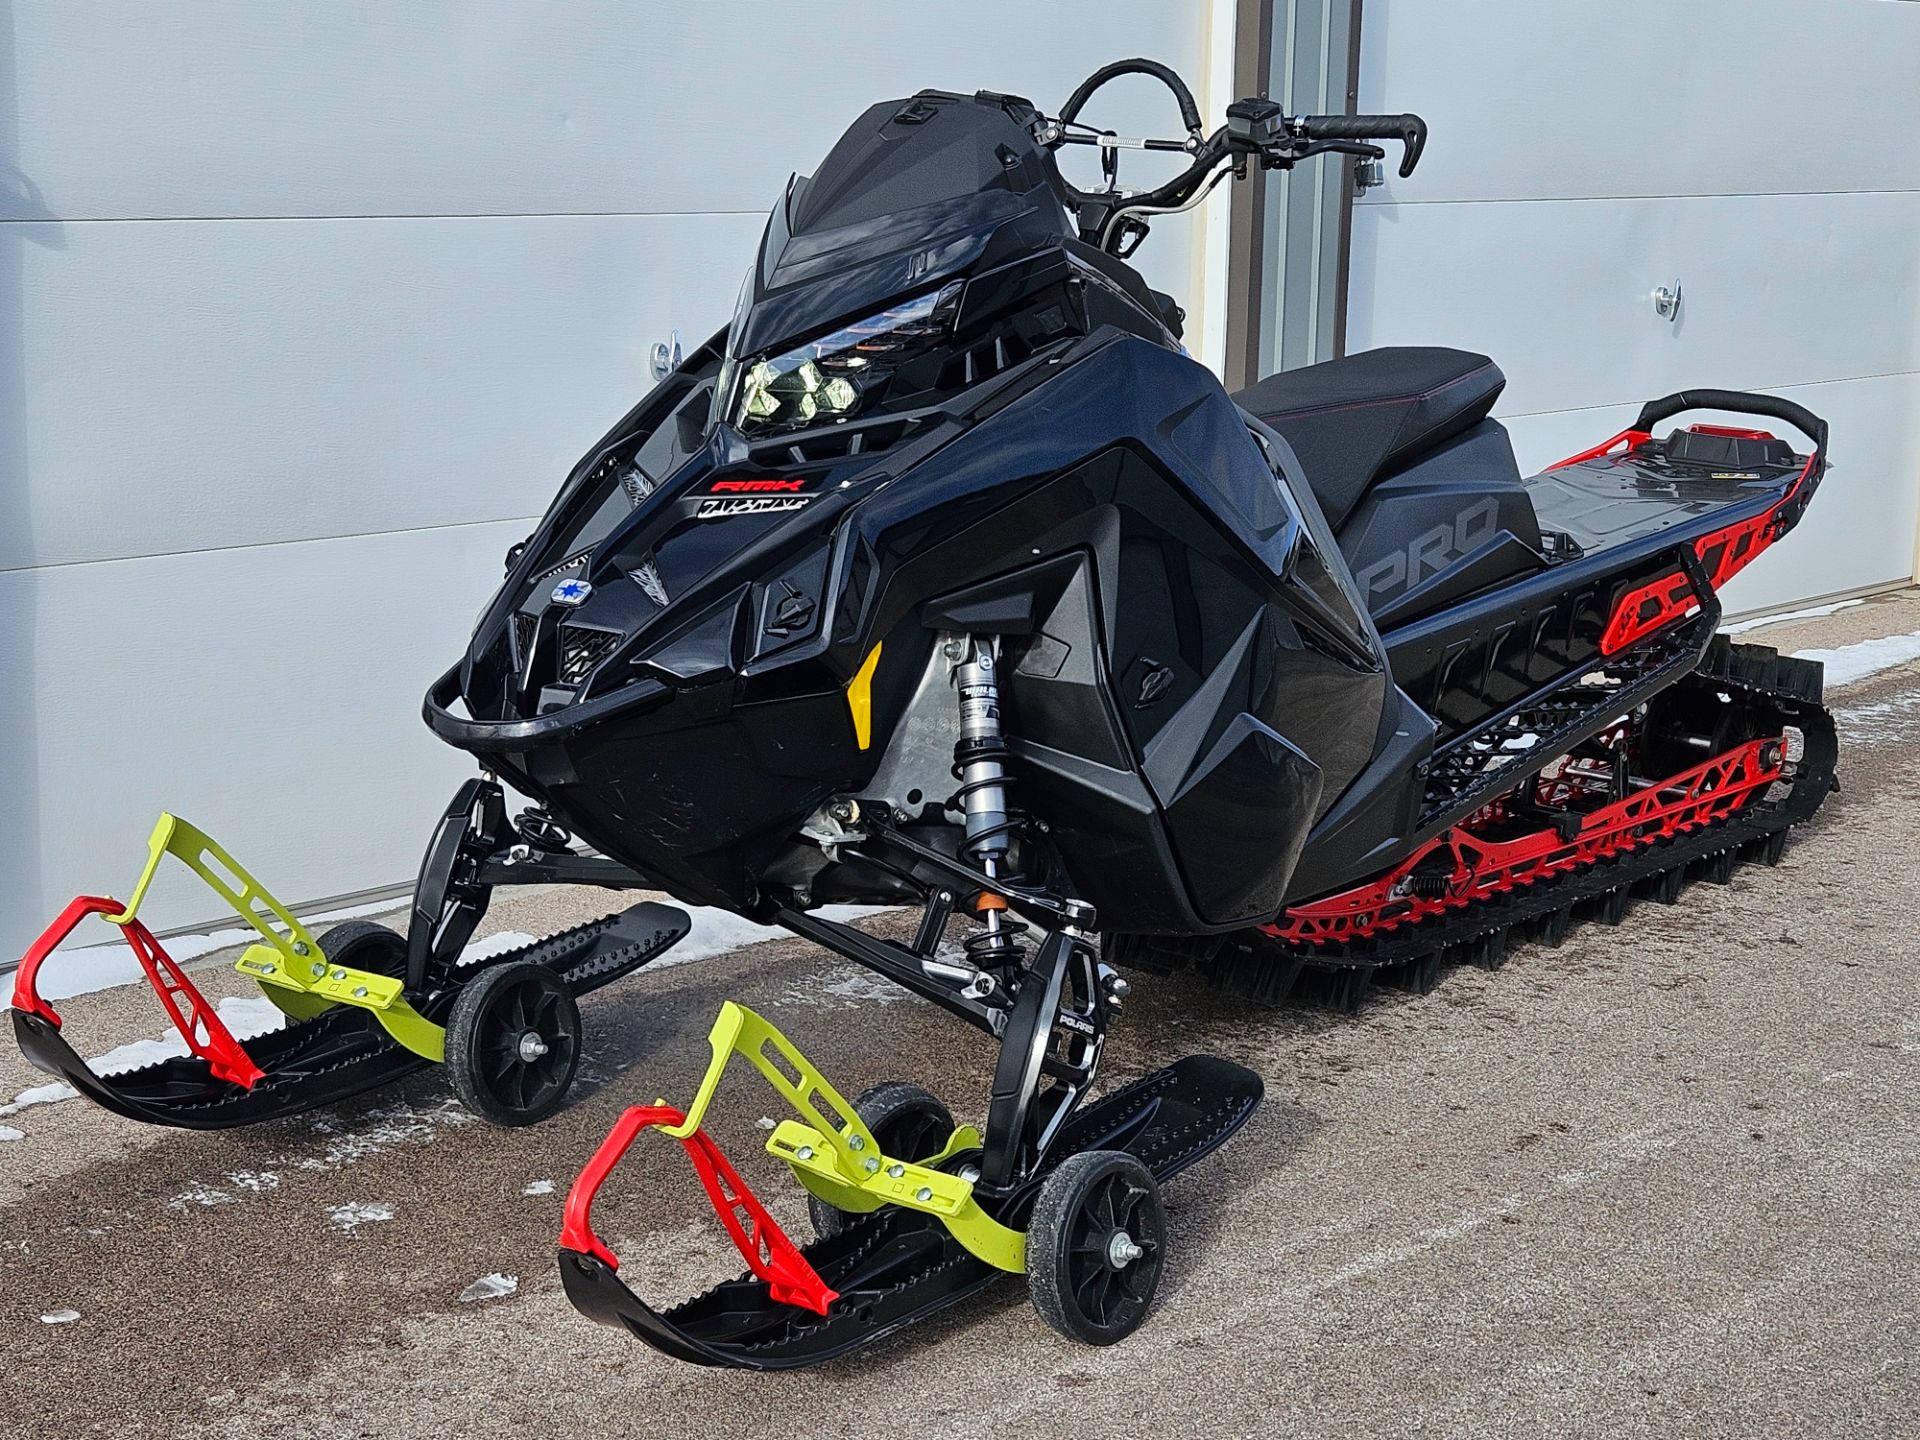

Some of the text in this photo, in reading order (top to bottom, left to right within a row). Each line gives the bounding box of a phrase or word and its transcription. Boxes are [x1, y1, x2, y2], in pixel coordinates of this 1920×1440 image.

[710, 479, 807, 493] RMK
[1355, 496, 1500, 609] PRO
[1059, 1014, 1095, 1035] POLARIS
